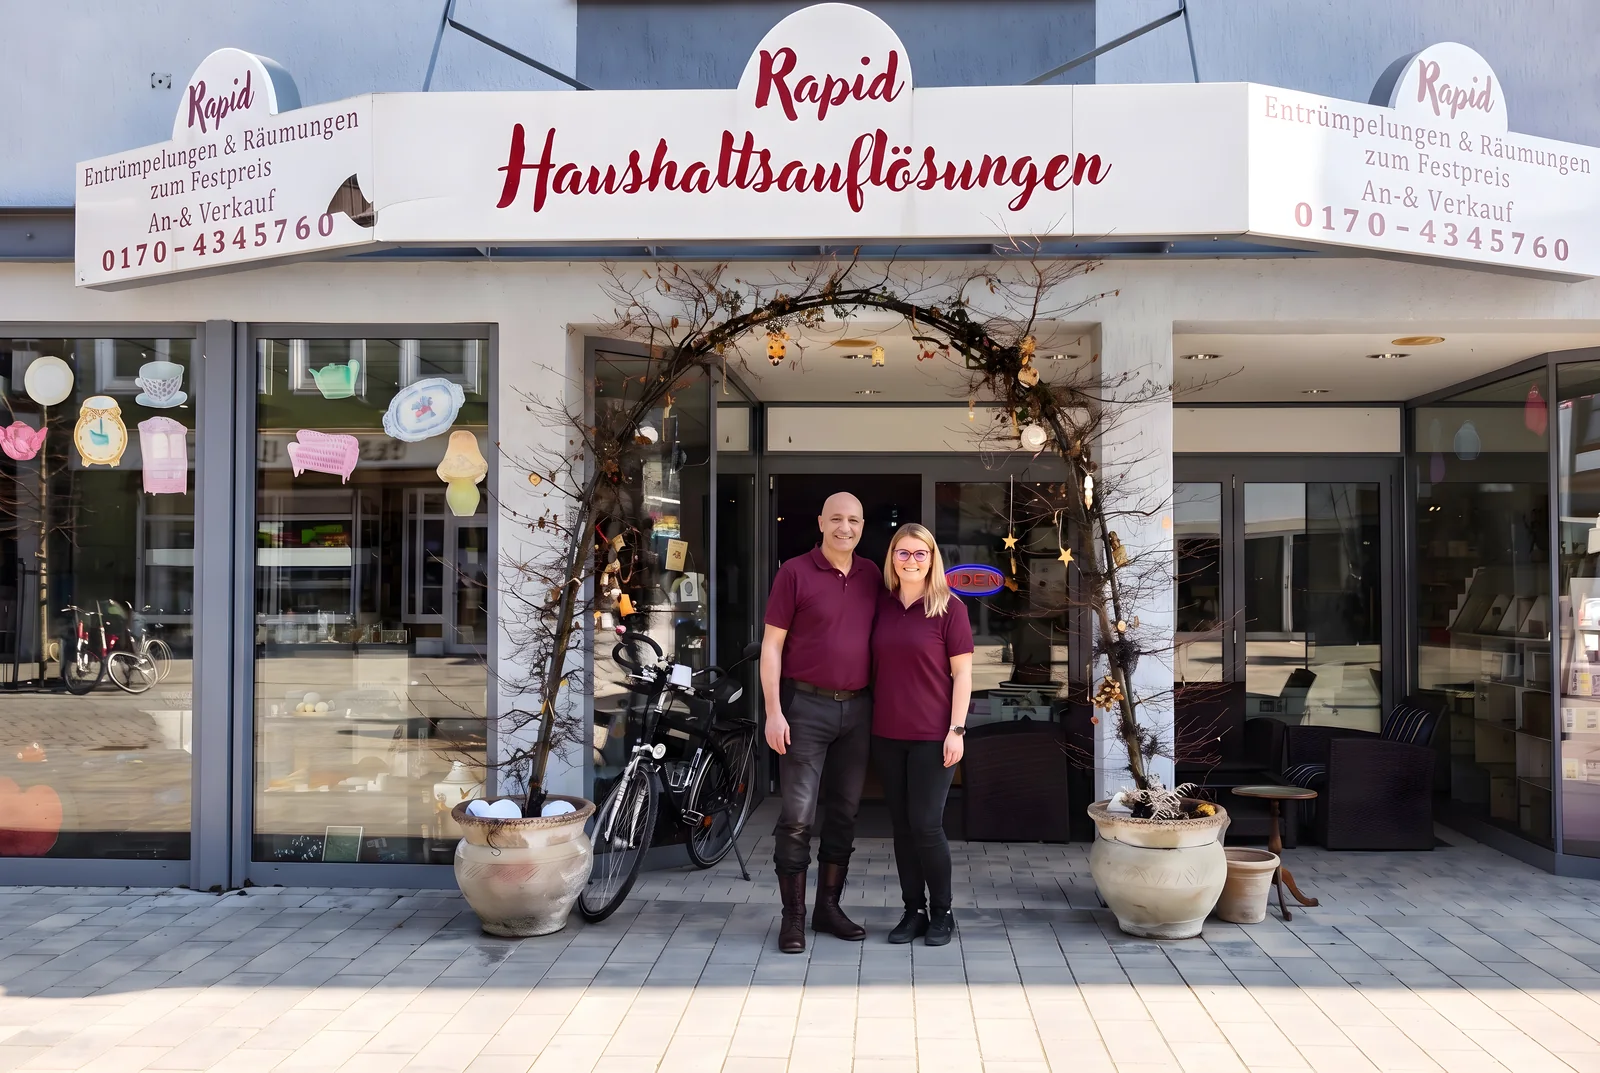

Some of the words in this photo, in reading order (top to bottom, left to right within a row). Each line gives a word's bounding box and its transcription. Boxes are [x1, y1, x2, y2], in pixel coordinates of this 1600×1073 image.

[188, 69, 255, 134] Rapid
[755, 46, 904, 121] Rapid
[1417, 59, 1495, 120] Rapid
[84, 143, 217, 187] Entrümpelungen
[223, 134, 237, 155] &
[243, 110, 359, 151] Räumungen
[1264, 95, 1451, 149] Entrümpelungen
[1458, 131, 1474, 153] &
[1480, 134, 1592, 176] Räumungen
[150, 176, 185, 200] zum
[191, 158, 272, 192] Festpreis
[496, 123, 1112, 213] Haushaltsauflösungen
[1364, 149, 1410, 172] zum
[1418, 153, 1511, 188] Festpreis
[199, 188, 276, 224] Verkauf
[1428, 189, 1515, 223] Verkauf
